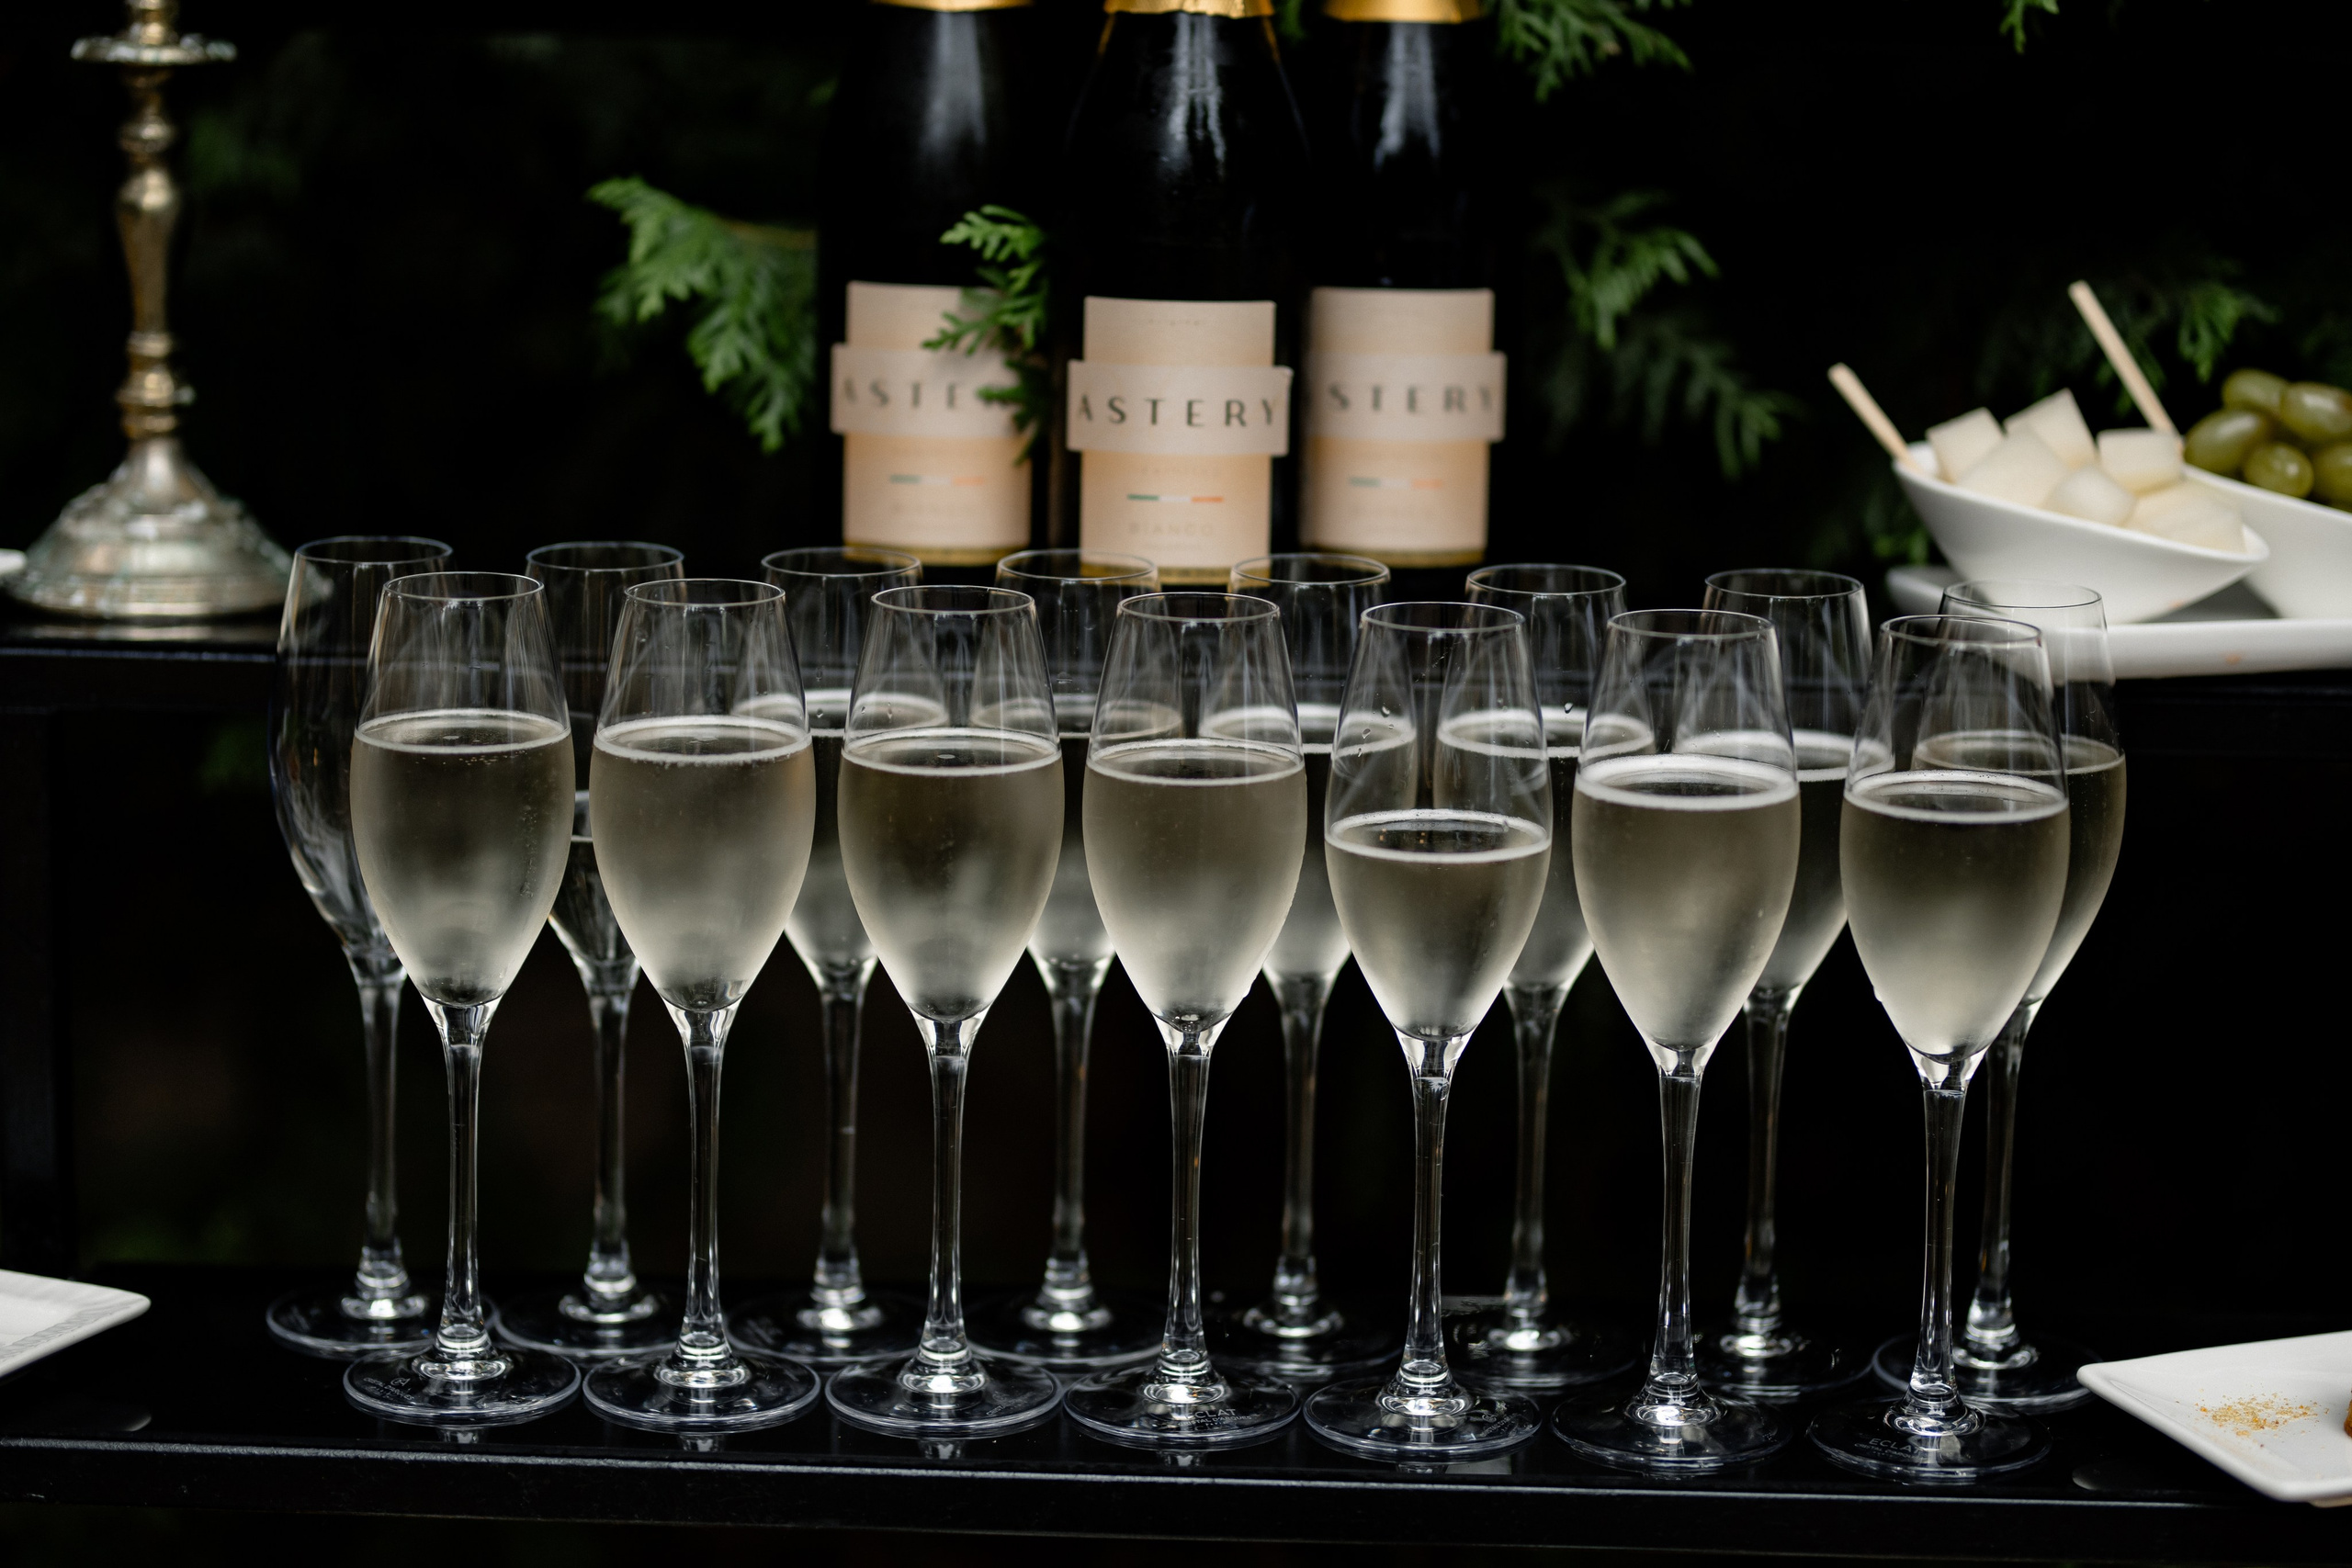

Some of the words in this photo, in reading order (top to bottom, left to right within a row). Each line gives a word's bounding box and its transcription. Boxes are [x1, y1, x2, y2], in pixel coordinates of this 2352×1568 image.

[842, 377, 1010, 411] ASTE
[1075, 392, 1278, 428] ASTERY
[1129, 522, 1215, 537] BIANCO
[1192, 1408, 1236, 1419] CLAT
